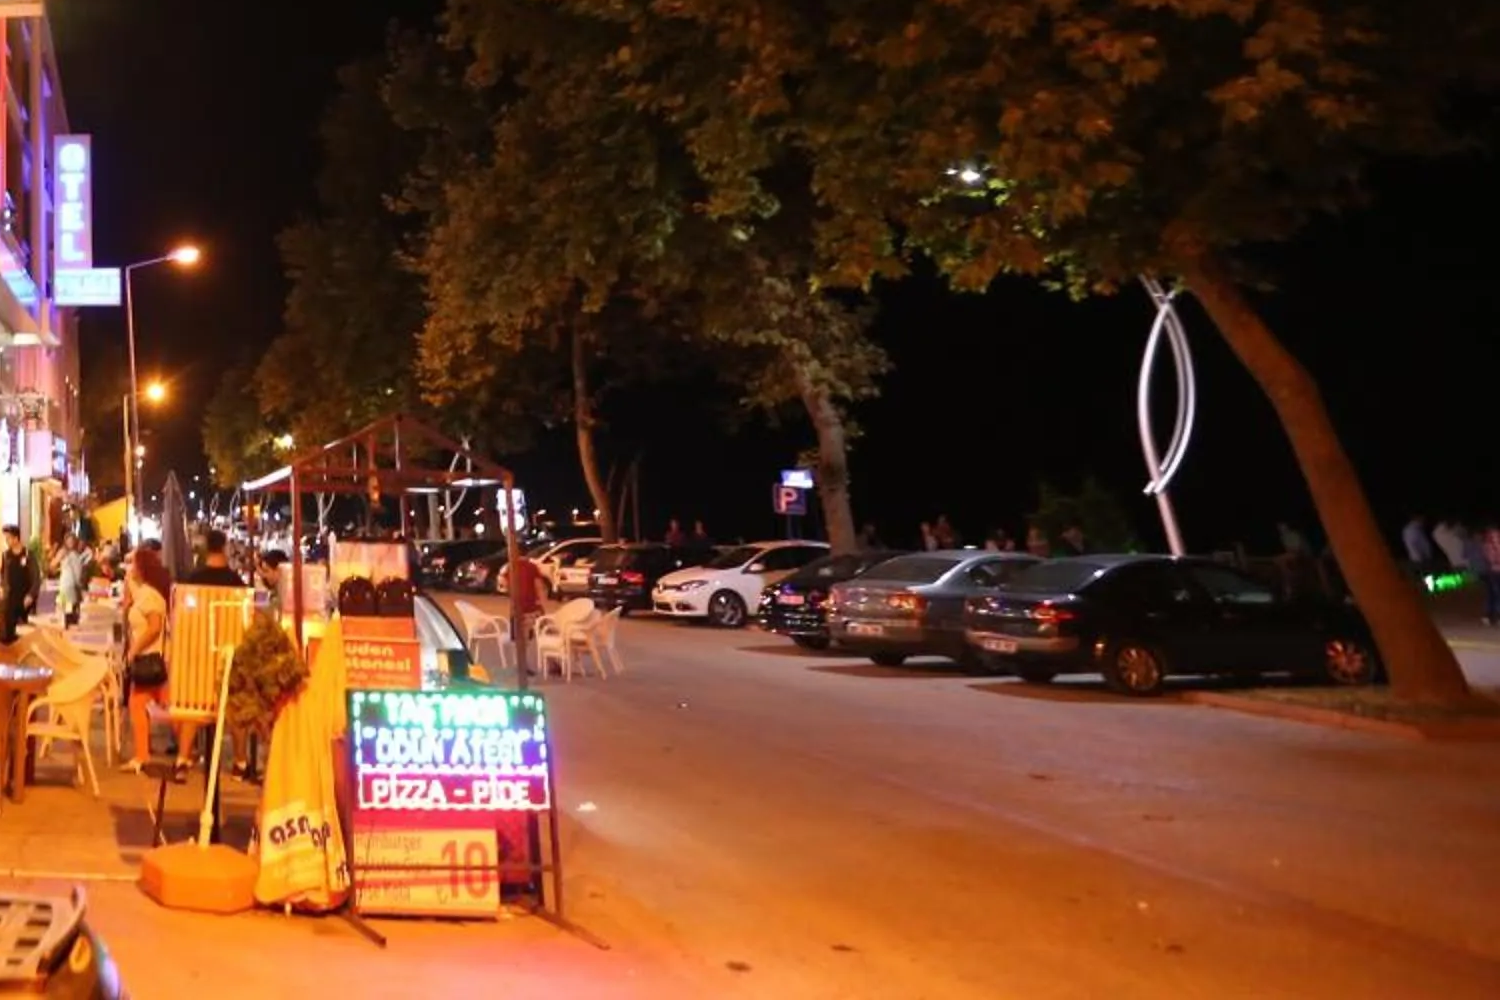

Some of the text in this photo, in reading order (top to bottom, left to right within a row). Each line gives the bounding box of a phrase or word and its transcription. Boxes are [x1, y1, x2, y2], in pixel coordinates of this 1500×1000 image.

[59, 142, 87, 263] OTEL
[780, 486, 799, 513] P
[441, 839, 491, 900] 10
